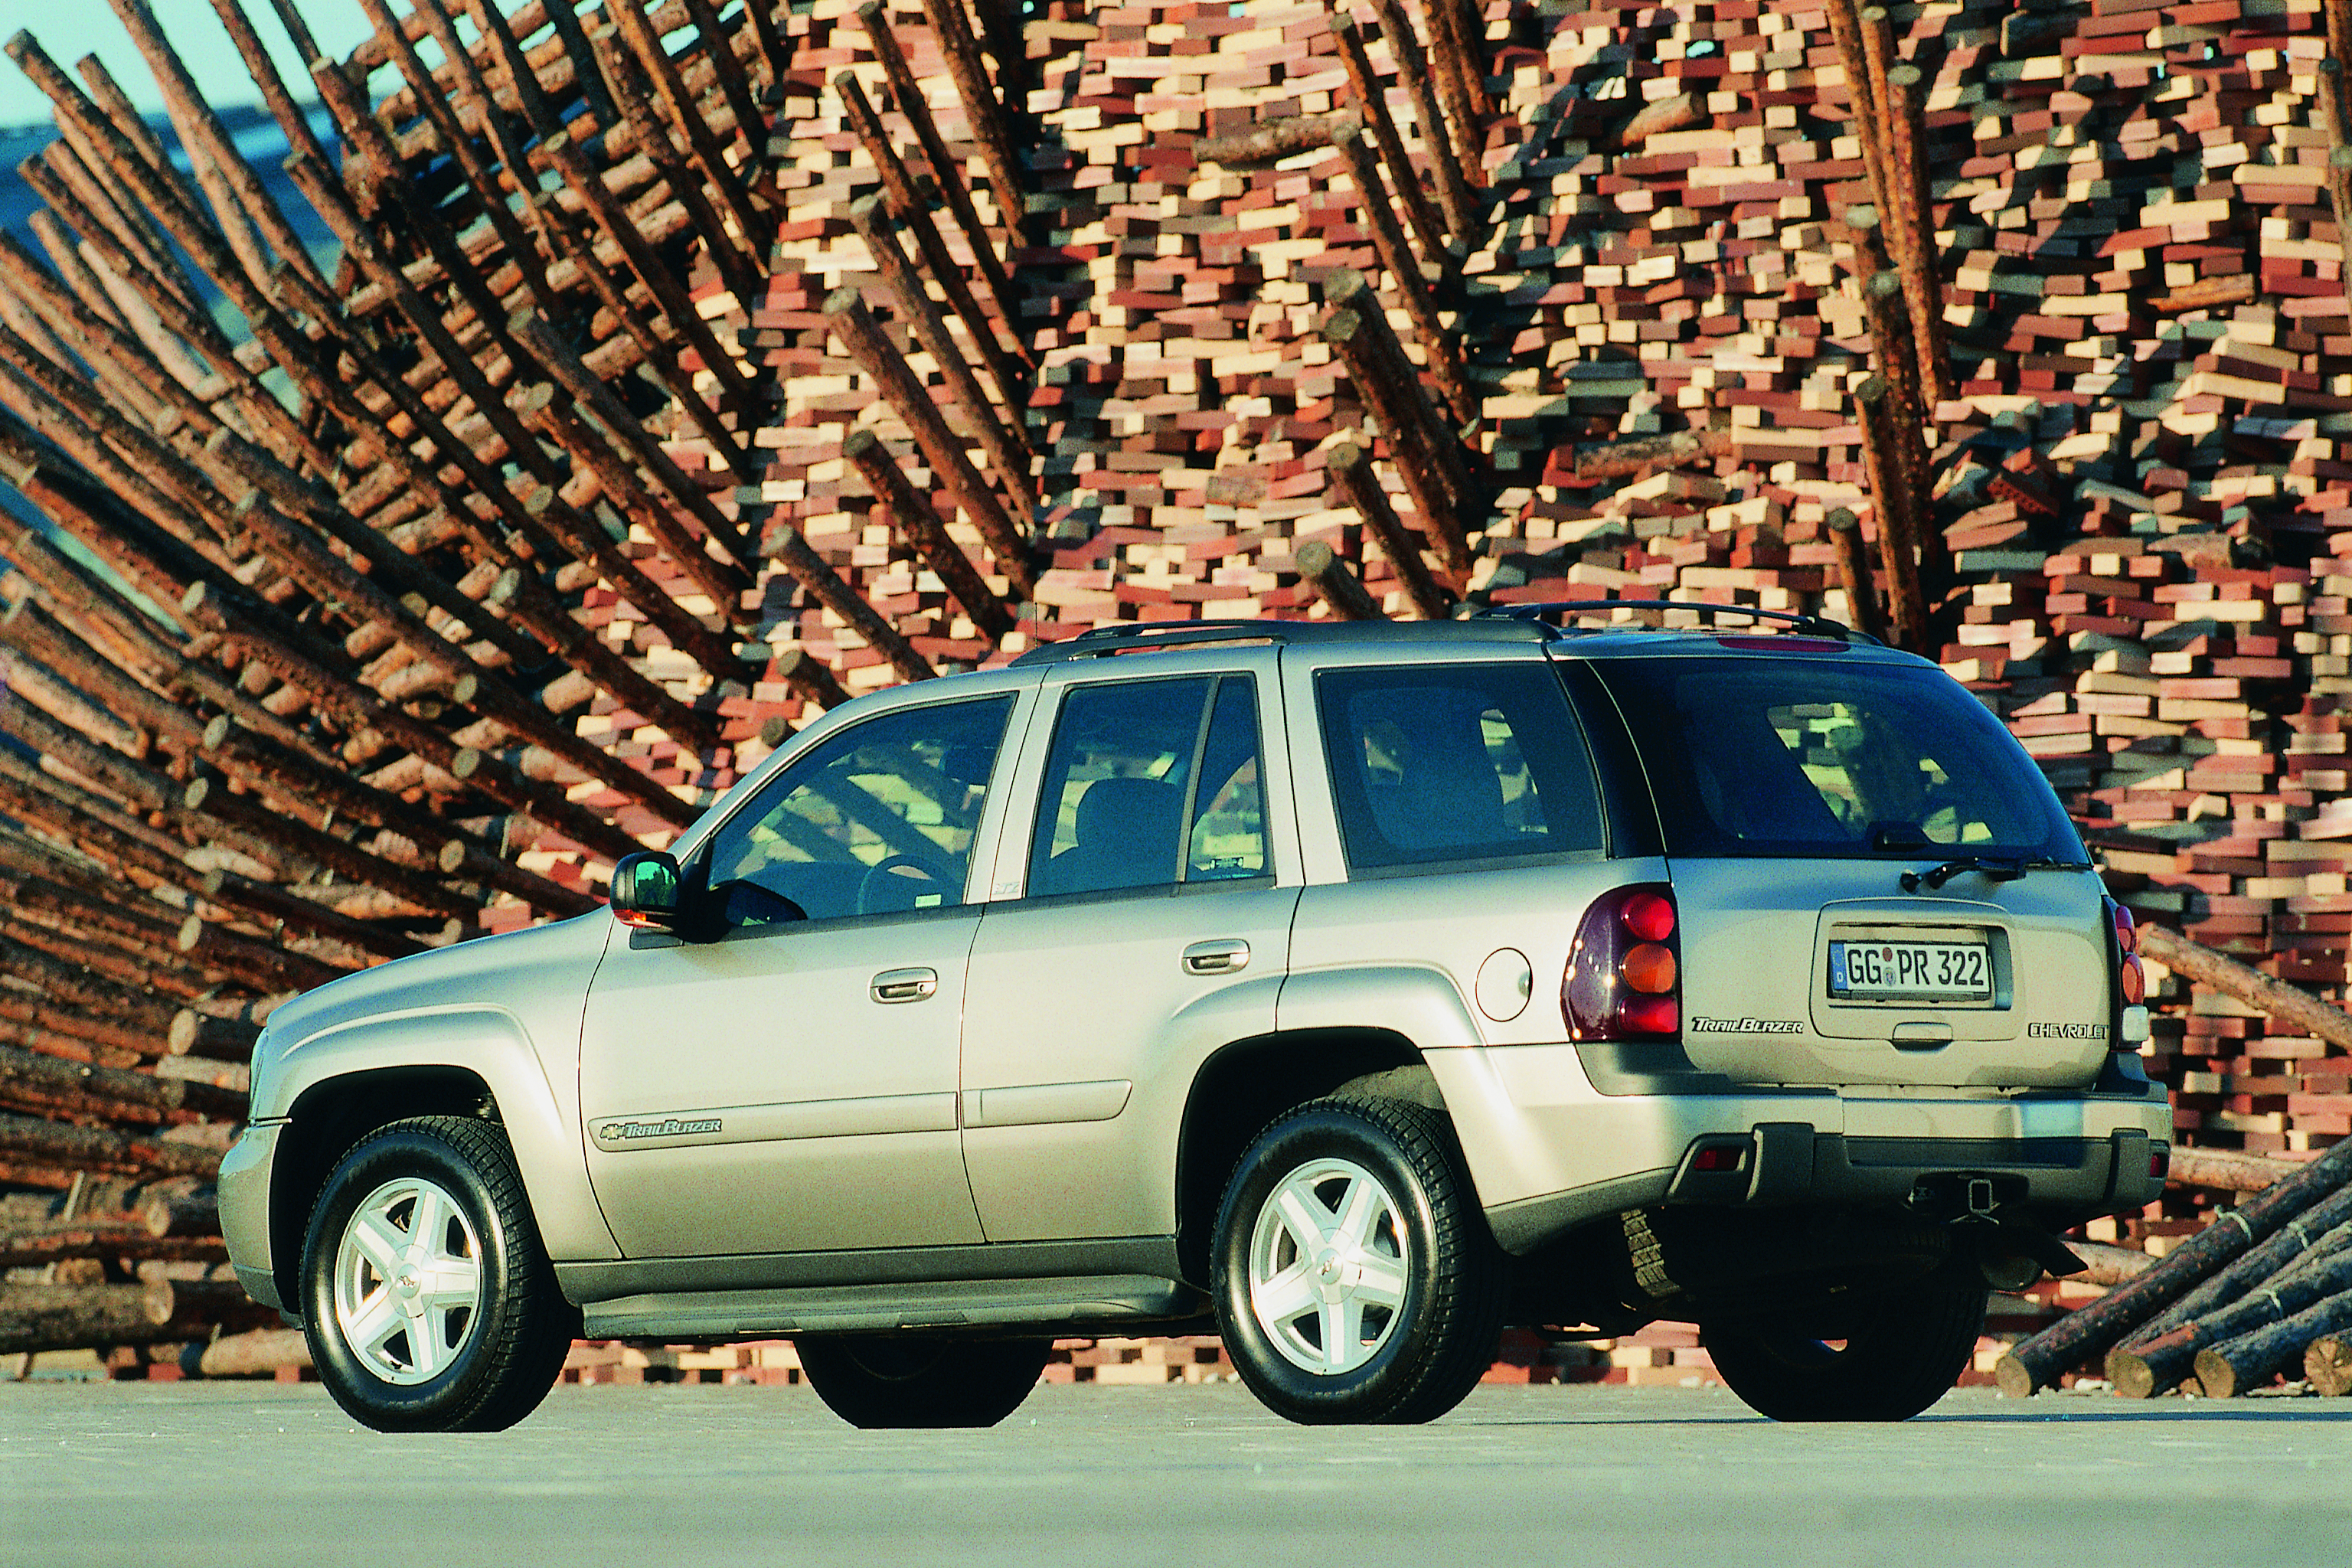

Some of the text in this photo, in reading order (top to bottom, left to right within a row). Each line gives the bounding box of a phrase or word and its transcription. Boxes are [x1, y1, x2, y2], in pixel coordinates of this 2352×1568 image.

[1847, 949, 1984, 986] GG PR 322
[2028, 1022, 2109, 1040] CHEVROLET
